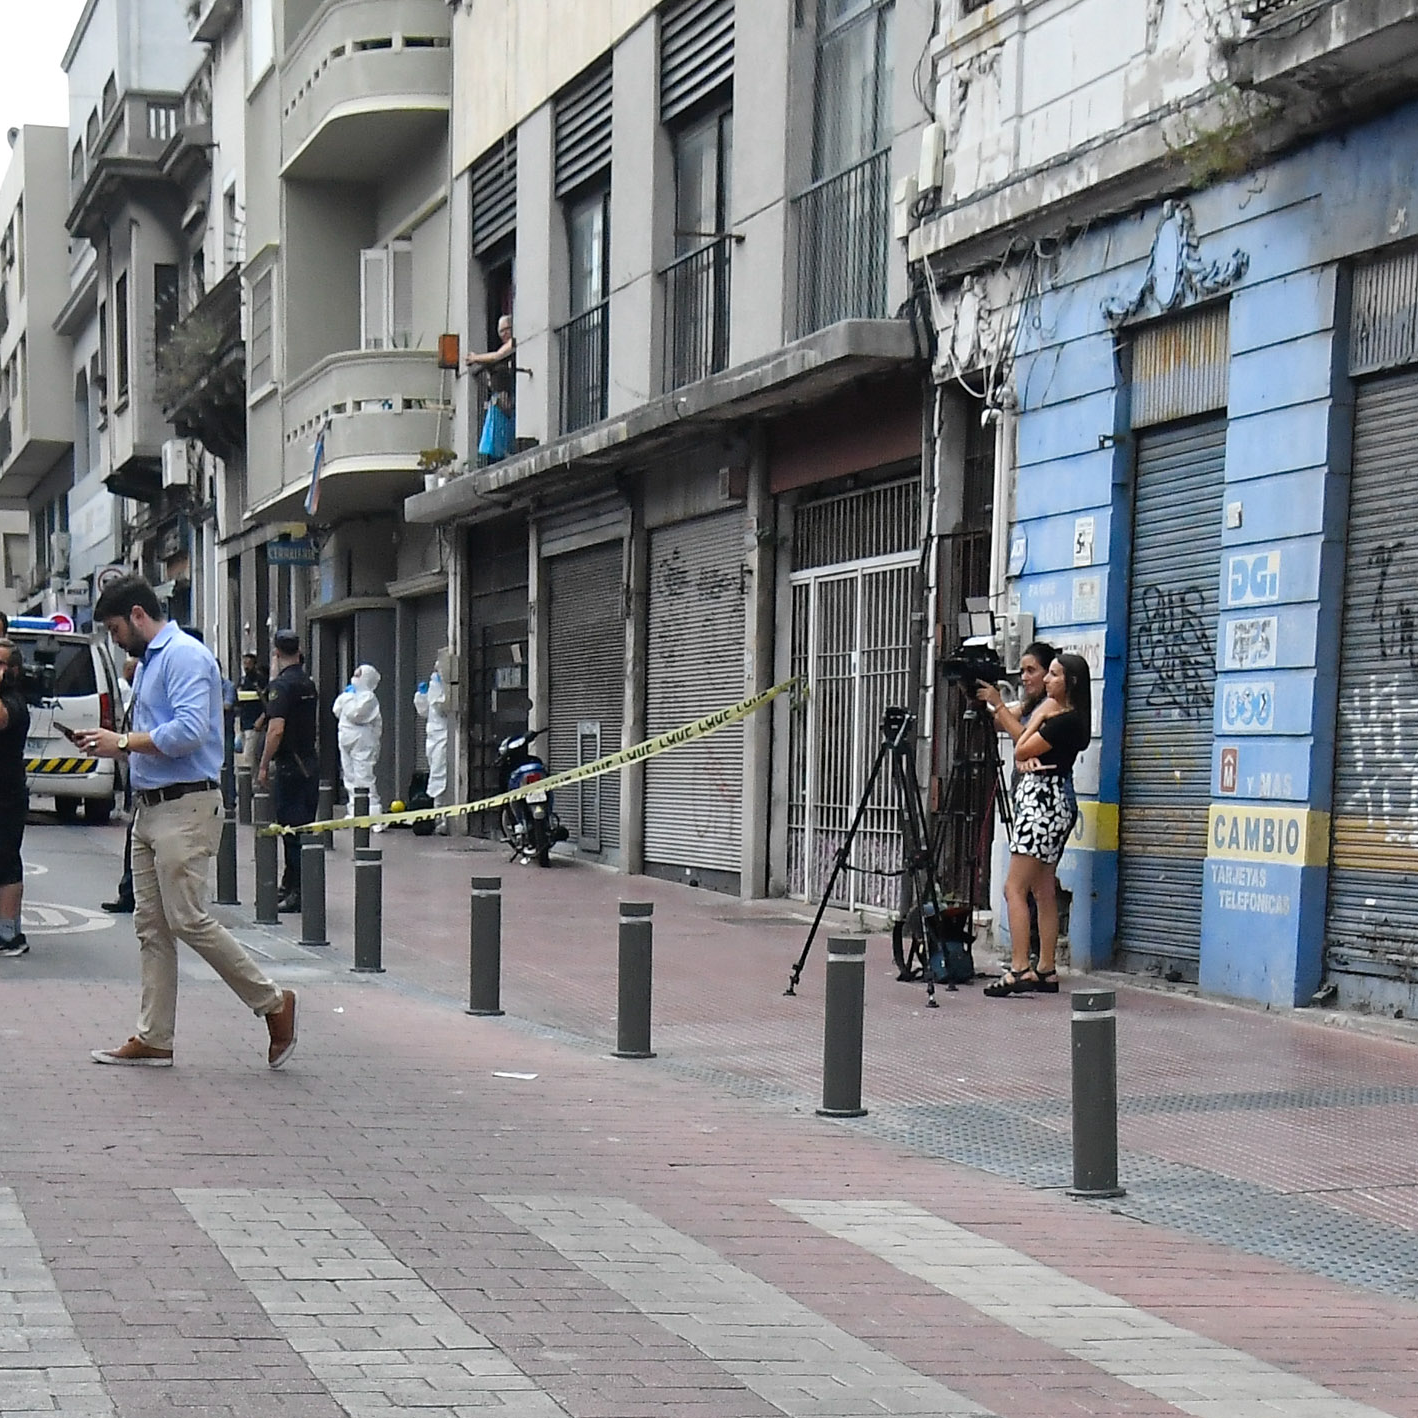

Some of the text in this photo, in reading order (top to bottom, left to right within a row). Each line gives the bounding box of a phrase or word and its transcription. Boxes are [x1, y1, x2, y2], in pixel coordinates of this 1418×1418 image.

[1259, 772, 1292, 798] MAS
[1214, 815, 1299, 855] CAMBIO
[1211, 865, 1266, 887] TARJETAS
[1219, 891, 1290, 915] TELEFONICAS
